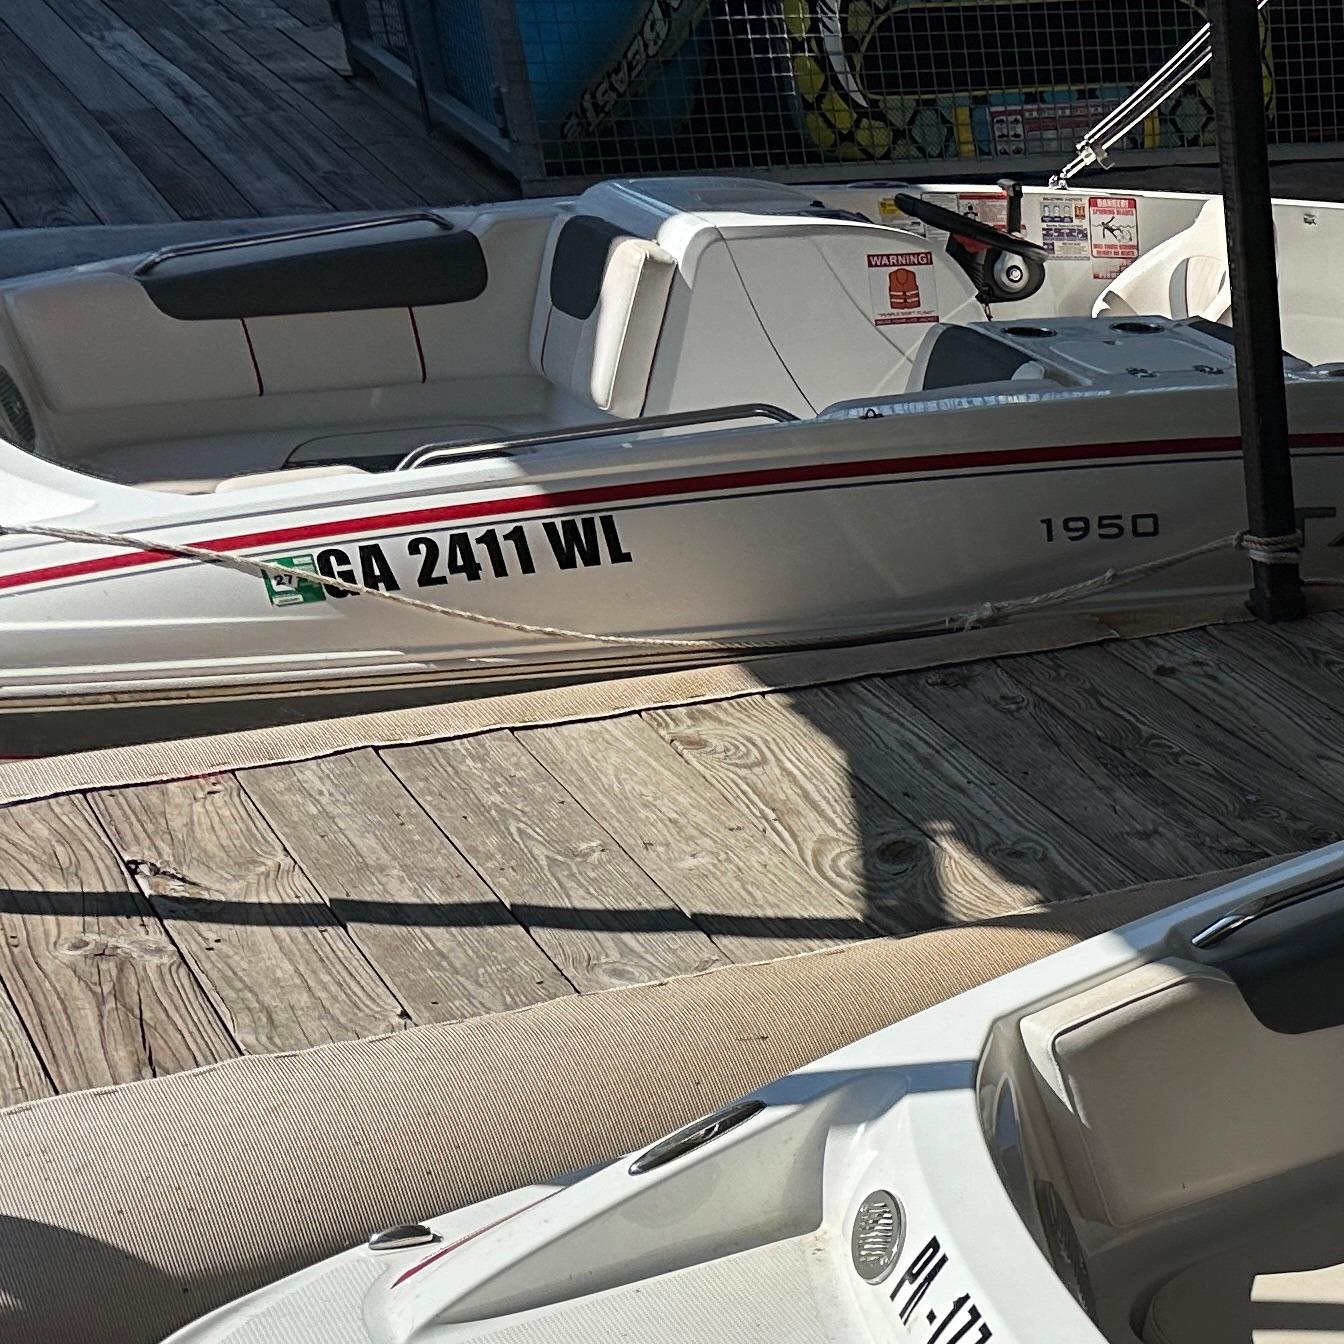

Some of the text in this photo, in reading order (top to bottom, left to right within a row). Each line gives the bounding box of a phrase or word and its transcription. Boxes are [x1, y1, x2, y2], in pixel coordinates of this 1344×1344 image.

[868, 253, 931, 266] WARNING!
[1040, 513, 1159, 542] 1950
[316, 514, 633, 599] GA 2411 WL
[274, 573, 293, 586] 27
